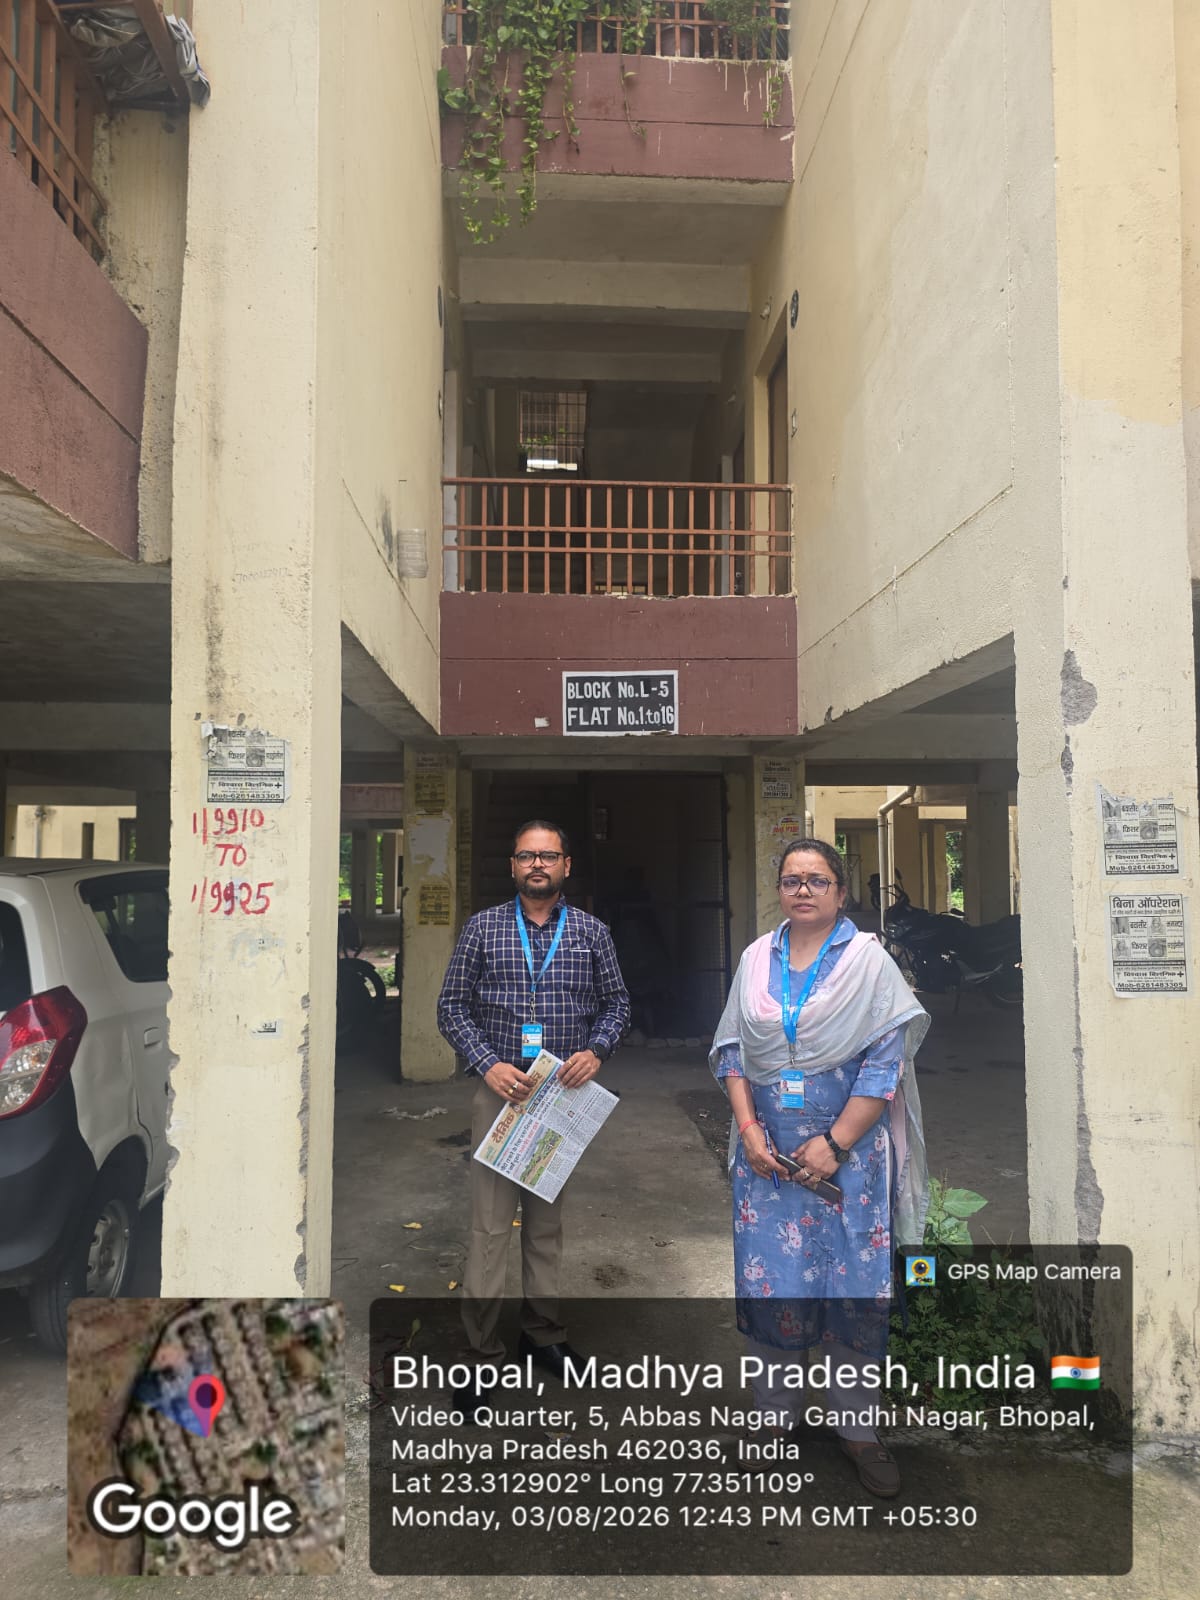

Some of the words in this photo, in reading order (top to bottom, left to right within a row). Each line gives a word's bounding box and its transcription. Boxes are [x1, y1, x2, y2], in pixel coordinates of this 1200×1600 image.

[567, 681, 612, 700] BLOCK
[567, 706, 612, 726] FLAT
[1112, 896, 1135, 909] बिना
[1137, 895, 1181, 909] ऑपरेशन
[491, 1111, 516, 1145] दैनिक
